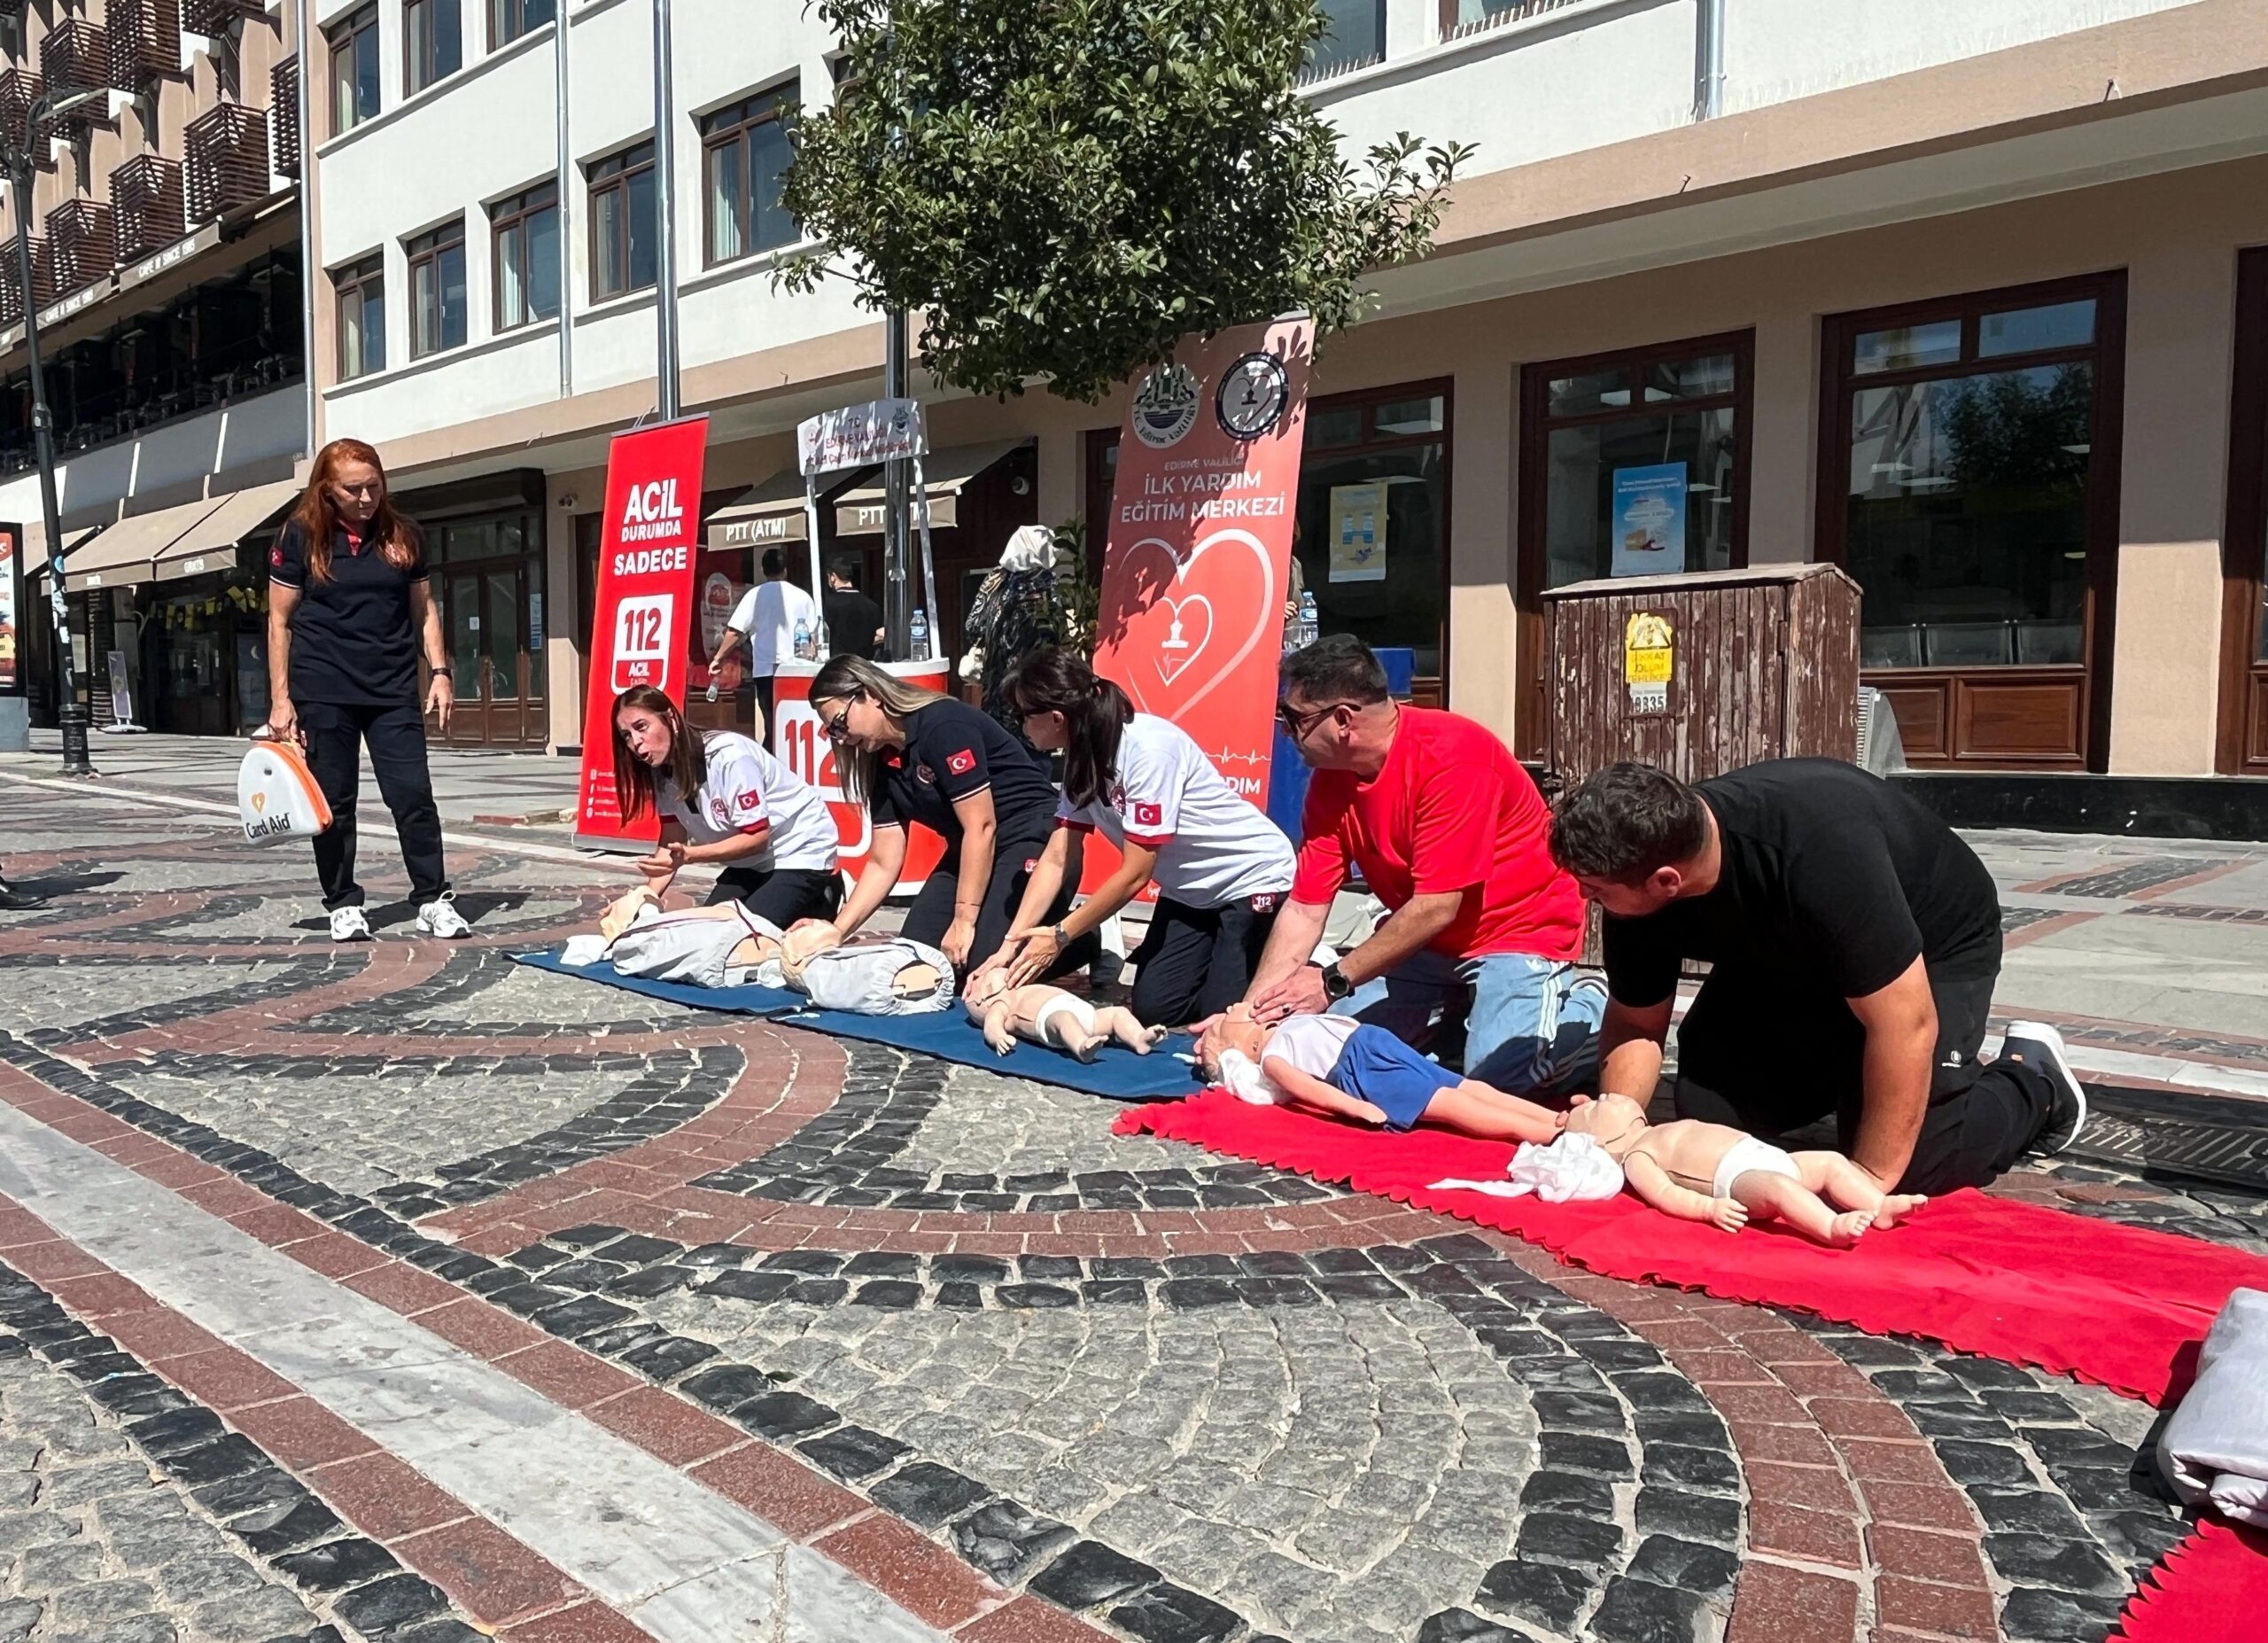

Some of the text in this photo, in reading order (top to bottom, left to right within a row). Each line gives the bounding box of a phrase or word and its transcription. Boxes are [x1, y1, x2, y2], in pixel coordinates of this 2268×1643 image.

[1145, 470, 1262, 494] İLK YARDIM
[1122, 491, 1285, 523] EĞİTİM MERKEZİ
[621, 519, 681, 543] DURUMDA
[726, 518, 786, 541] PTT (ATM)
[614, 547, 687, 576] SADECE
[625, 608, 662, 651] 112
[785, 720, 841, 787] 112
[245, 818, 270, 838] Card
[1255, 896, 1272, 907] 112
